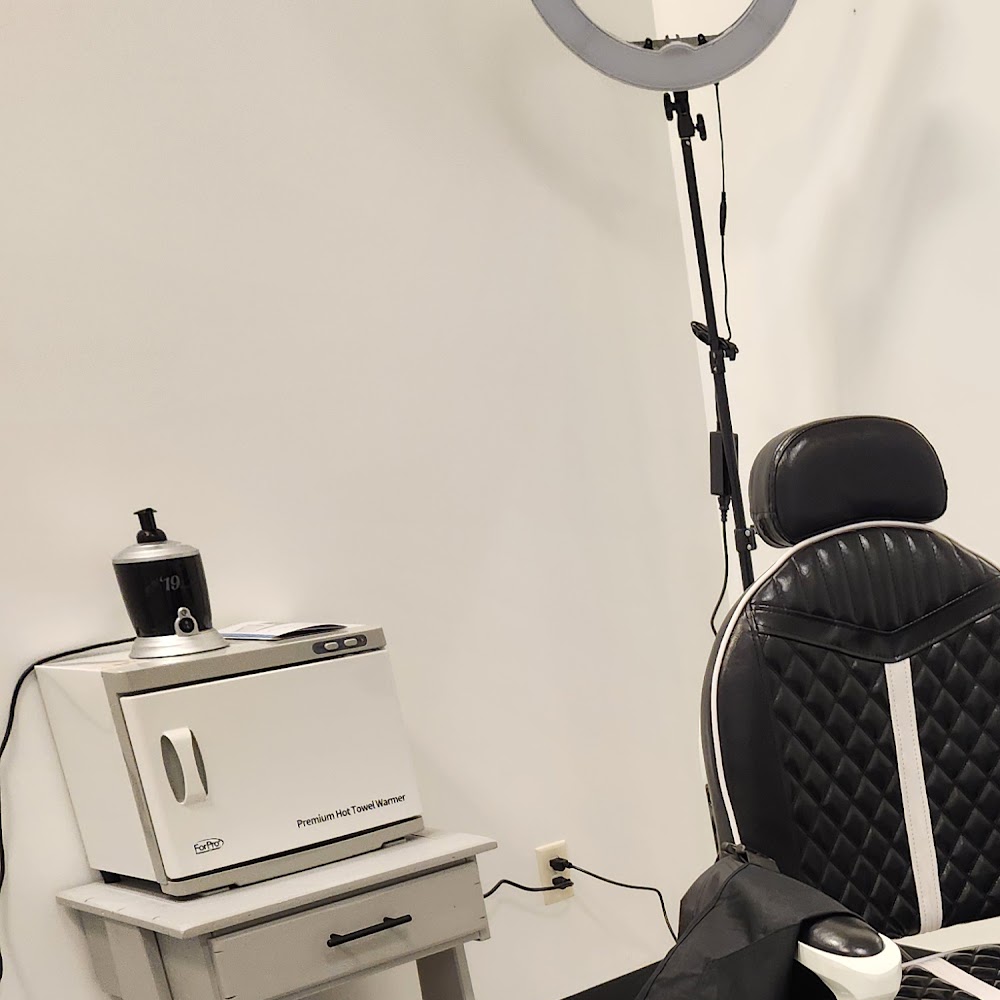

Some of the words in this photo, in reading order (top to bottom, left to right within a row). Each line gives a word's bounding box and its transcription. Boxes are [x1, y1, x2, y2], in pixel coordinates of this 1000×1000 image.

[297, 813, 335, 828] Premium
[335, 808, 351, 819] Hot
[351, 800, 376, 815] Towel
[376, 794, 406, 808] Warmer
[194, 839, 221, 854] ForPro
